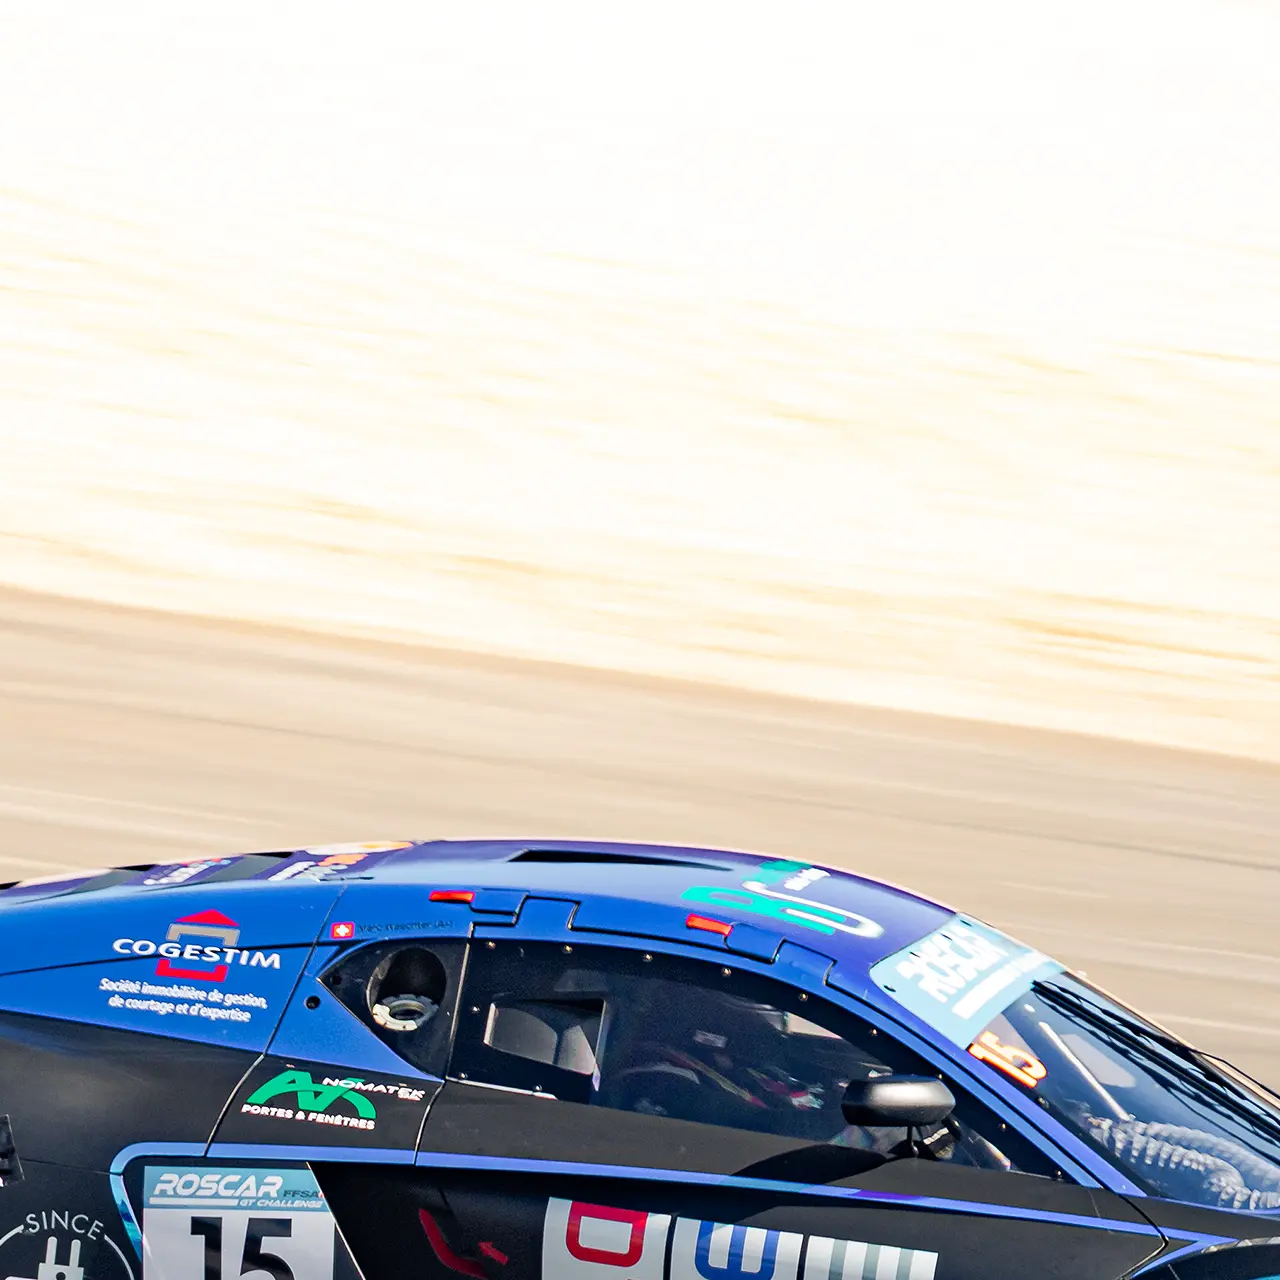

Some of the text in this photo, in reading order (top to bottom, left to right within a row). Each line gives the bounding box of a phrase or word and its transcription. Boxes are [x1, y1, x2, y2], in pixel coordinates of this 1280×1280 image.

[112, 938, 282, 969] COGESTIM
[99, 977, 141, 994] Société
[141, 982, 208, 1002] immobilière
[208, 989, 223, 1003] de
[108, 994, 252, 1023] de courtage et d'expertise
[968, 1031, 1048, 1089] 15
[322, 1077, 426, 1099] NOMATEK
[240, 1104, 376, 1130] PORTES & FENÊTRES
[153, 1173, 283, 1197] ROSCAR
[239, 1199, 324, 1209] GT CHALLENGE
[26, 1209, 104, 1240] SINCE
